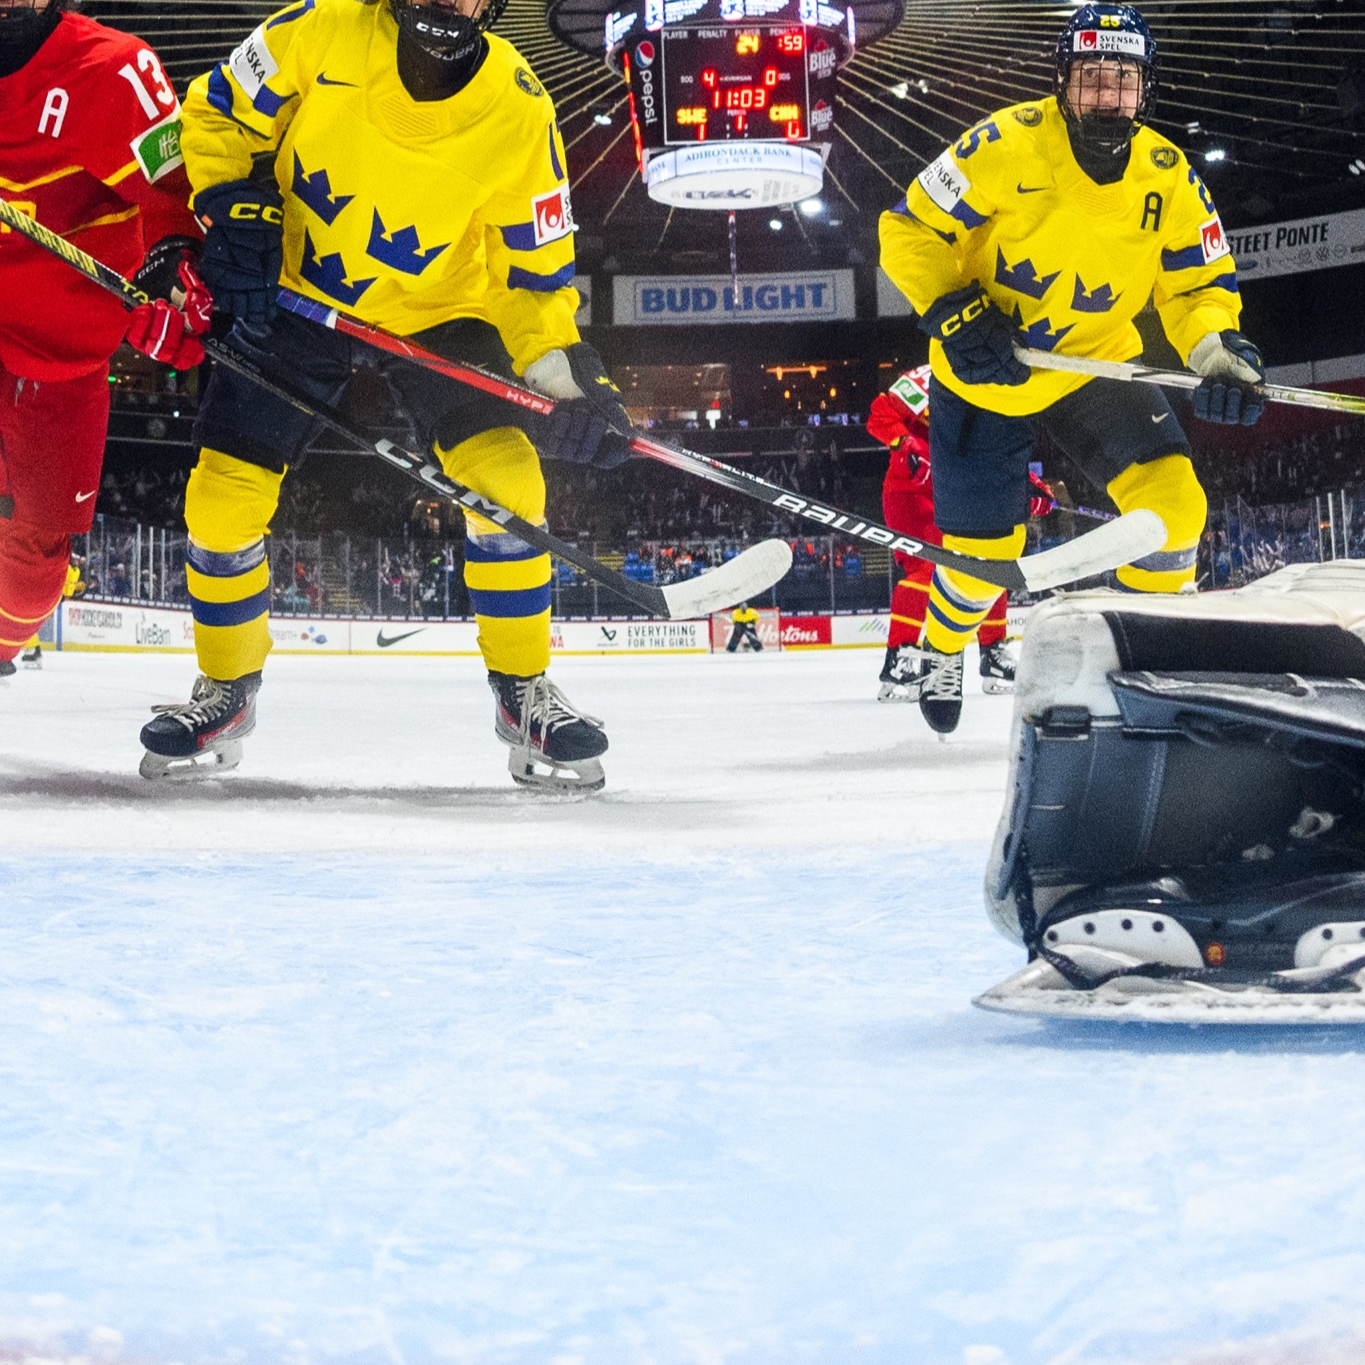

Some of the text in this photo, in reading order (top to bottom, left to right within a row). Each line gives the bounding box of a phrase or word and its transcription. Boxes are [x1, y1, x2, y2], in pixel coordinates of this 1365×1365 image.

[1099, 34, 1140, 46] SVENSKA
[1099, 43, 1122, 51] SPEL
[809, 51, 837, 73] Blue
[117, 48, 175, 122] 13
[703, 71, 715, 87] 4
[765, 69, 776, 86] 0
[639, 69, 658, 127] pepsi
[714, 88, 766, 108] 11:03
[37, 87, 70, 139] A
[676, 107, 708, 125] SWE
[955, 115, 1003, 160] 5
[685, 146, 792, 163] ADIRONDACK BANK
[716, 156, 763, 166] CENTER
[1140, 191, 1163, 233] A
[1275, 222, 1329, 250] PONTE
[137, 256, 165, 280] CCM
[641, 282, 828, 314] BUD LIGHT
[374, 437, 514, 525] CCM
[627, 625, 697, 636] EVERYTHING
[627, 637, 697, 648] FOR THE GIRLS
